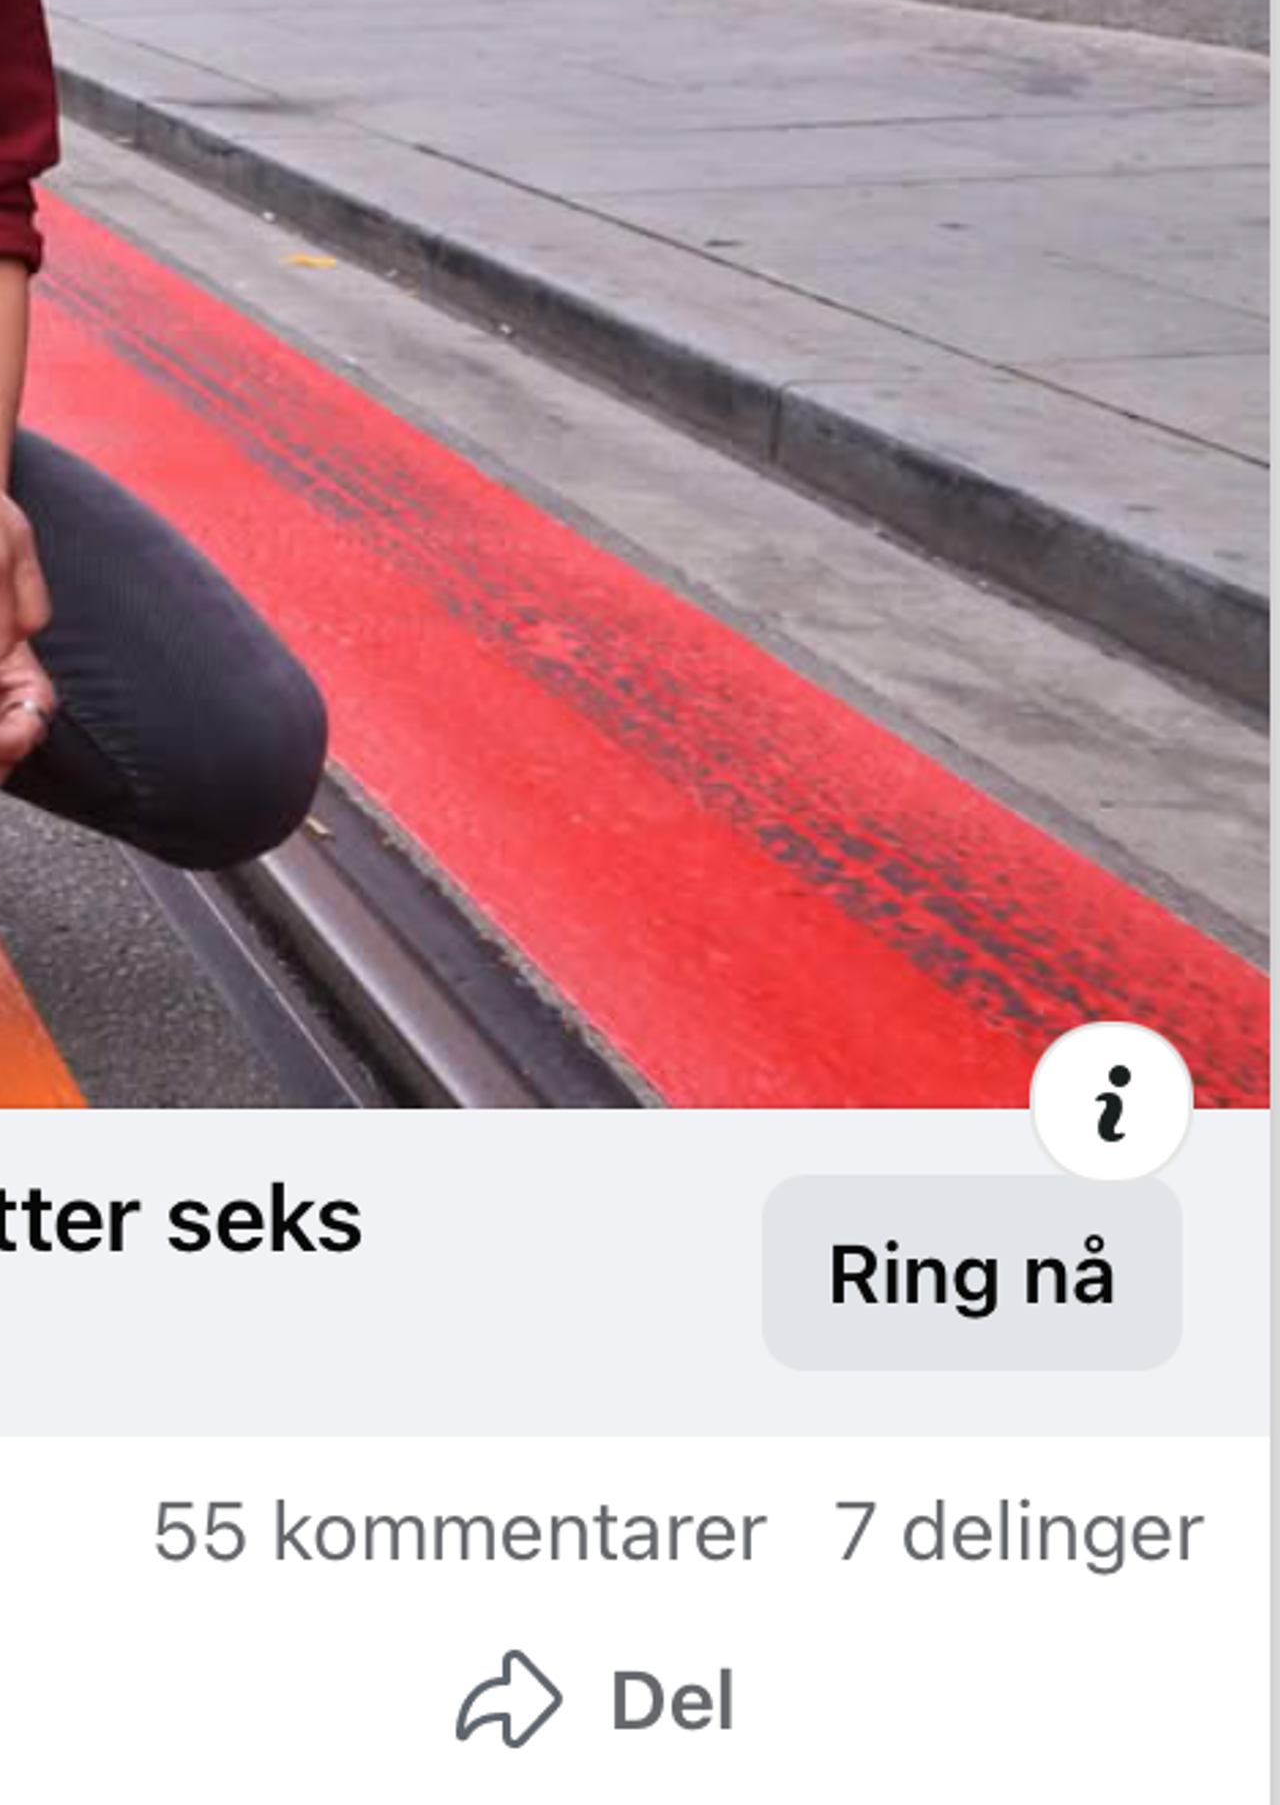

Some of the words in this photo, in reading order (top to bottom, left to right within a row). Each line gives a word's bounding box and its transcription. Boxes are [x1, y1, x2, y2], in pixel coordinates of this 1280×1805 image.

[167, 1181, 362, 1254] seks
[831, 1239, 998, 1320] Ring
[1026, 1233, 1114, 1305] nå
[156, 1501, 246, 1562] 55
[276, 1498, 768, 1561] kommentarer
[835, 1501, 877, 1561] 7
[903, 1498, 1205, 1576] delinger
[613, 1667, 732, 1731] Del
